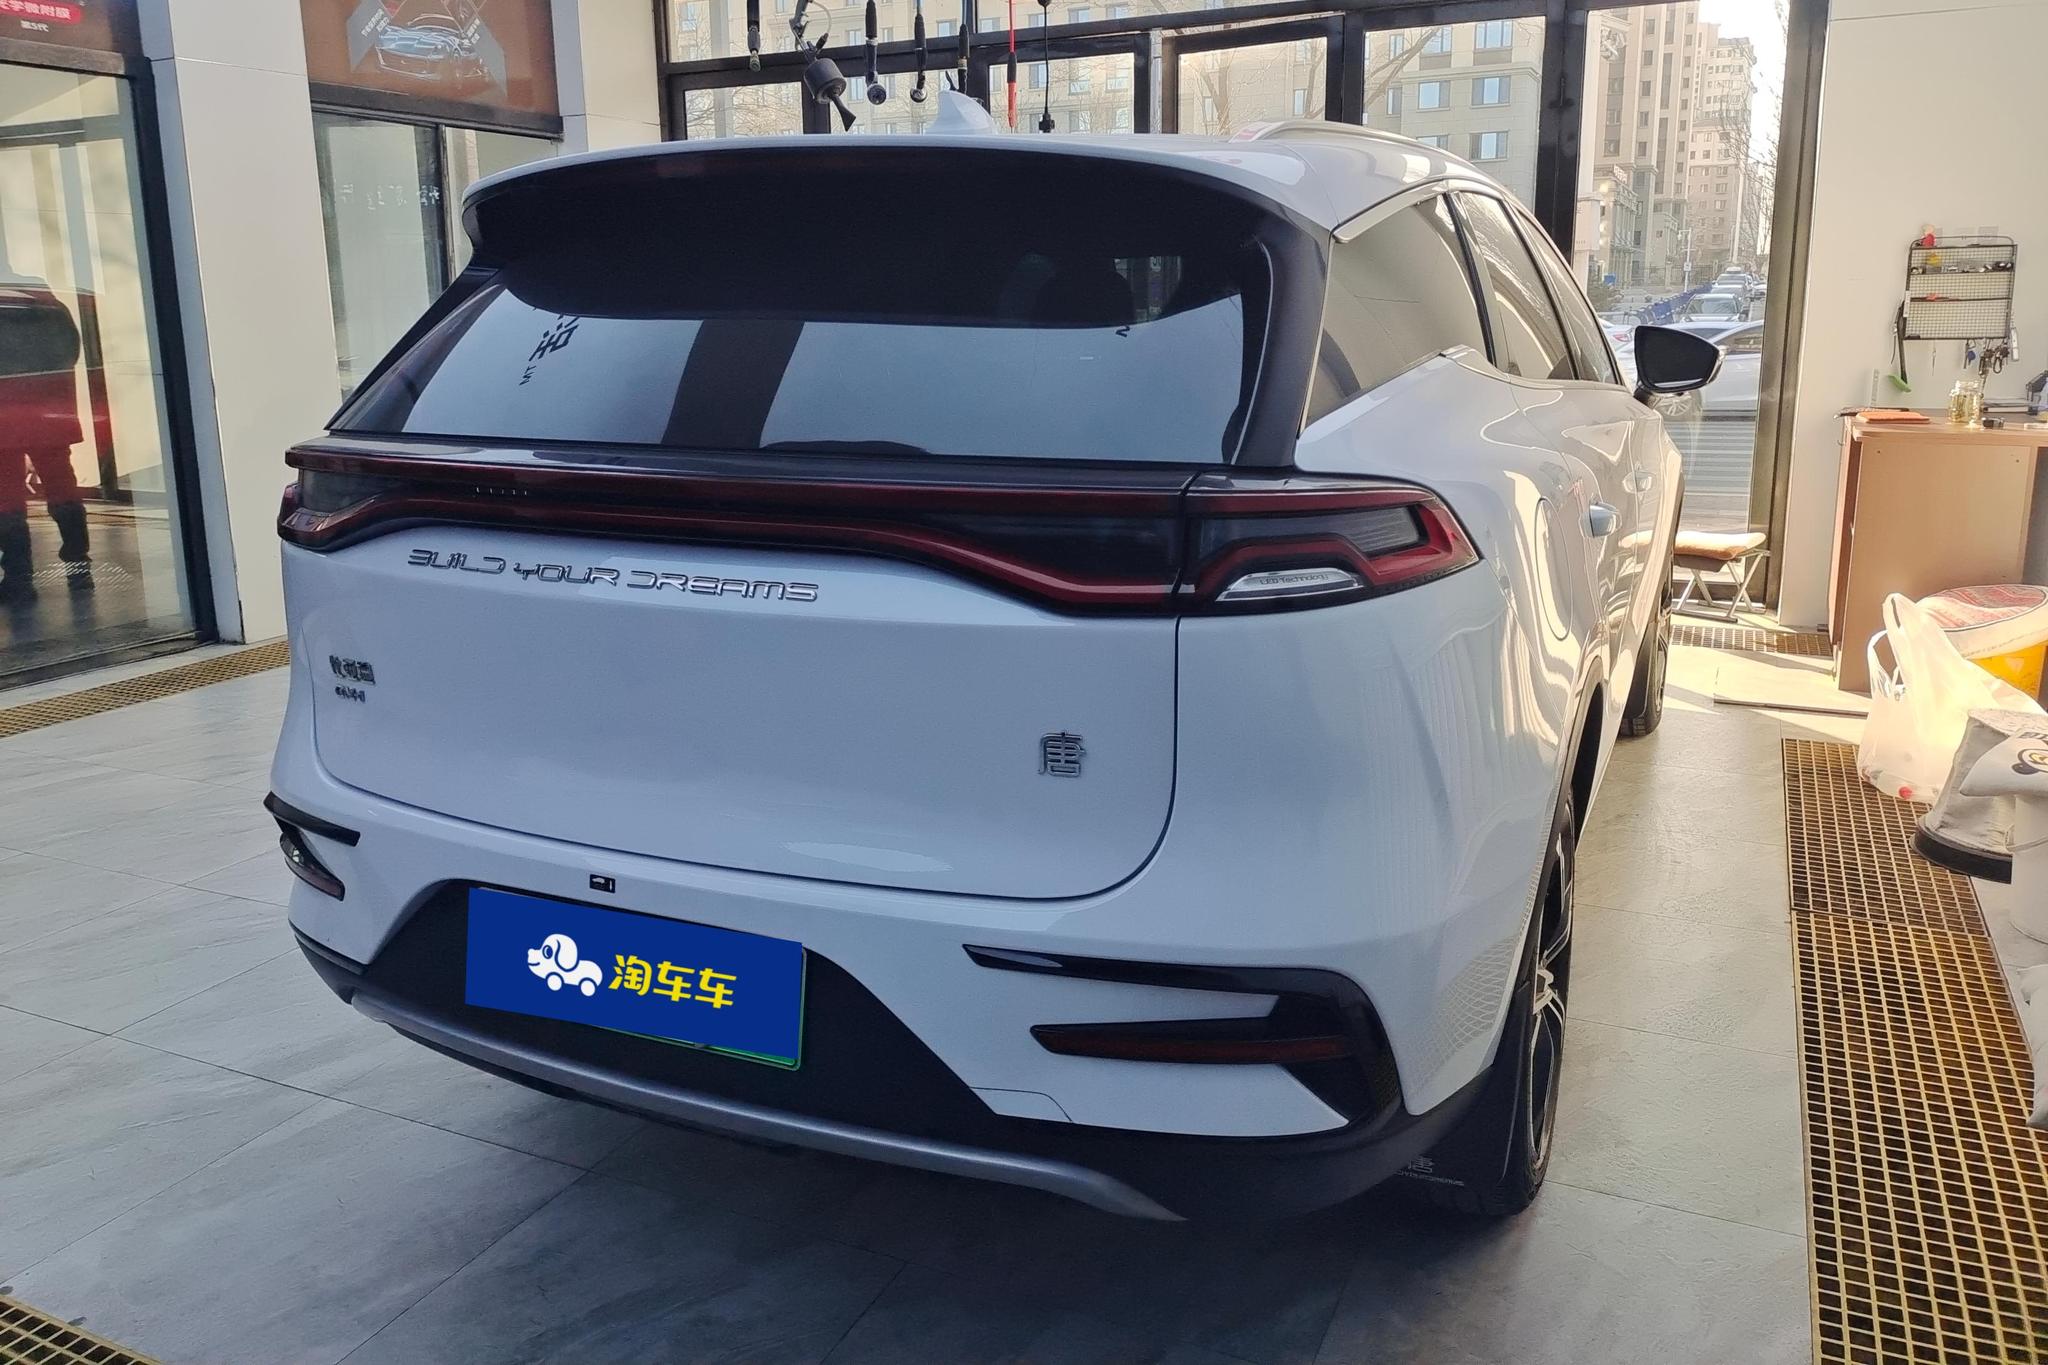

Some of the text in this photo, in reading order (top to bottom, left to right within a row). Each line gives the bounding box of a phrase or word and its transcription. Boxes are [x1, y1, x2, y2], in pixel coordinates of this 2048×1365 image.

[408, 549, 819, 602] BUILD YOUR DREAMS
[1038, 731, 1087, 778] 唐
